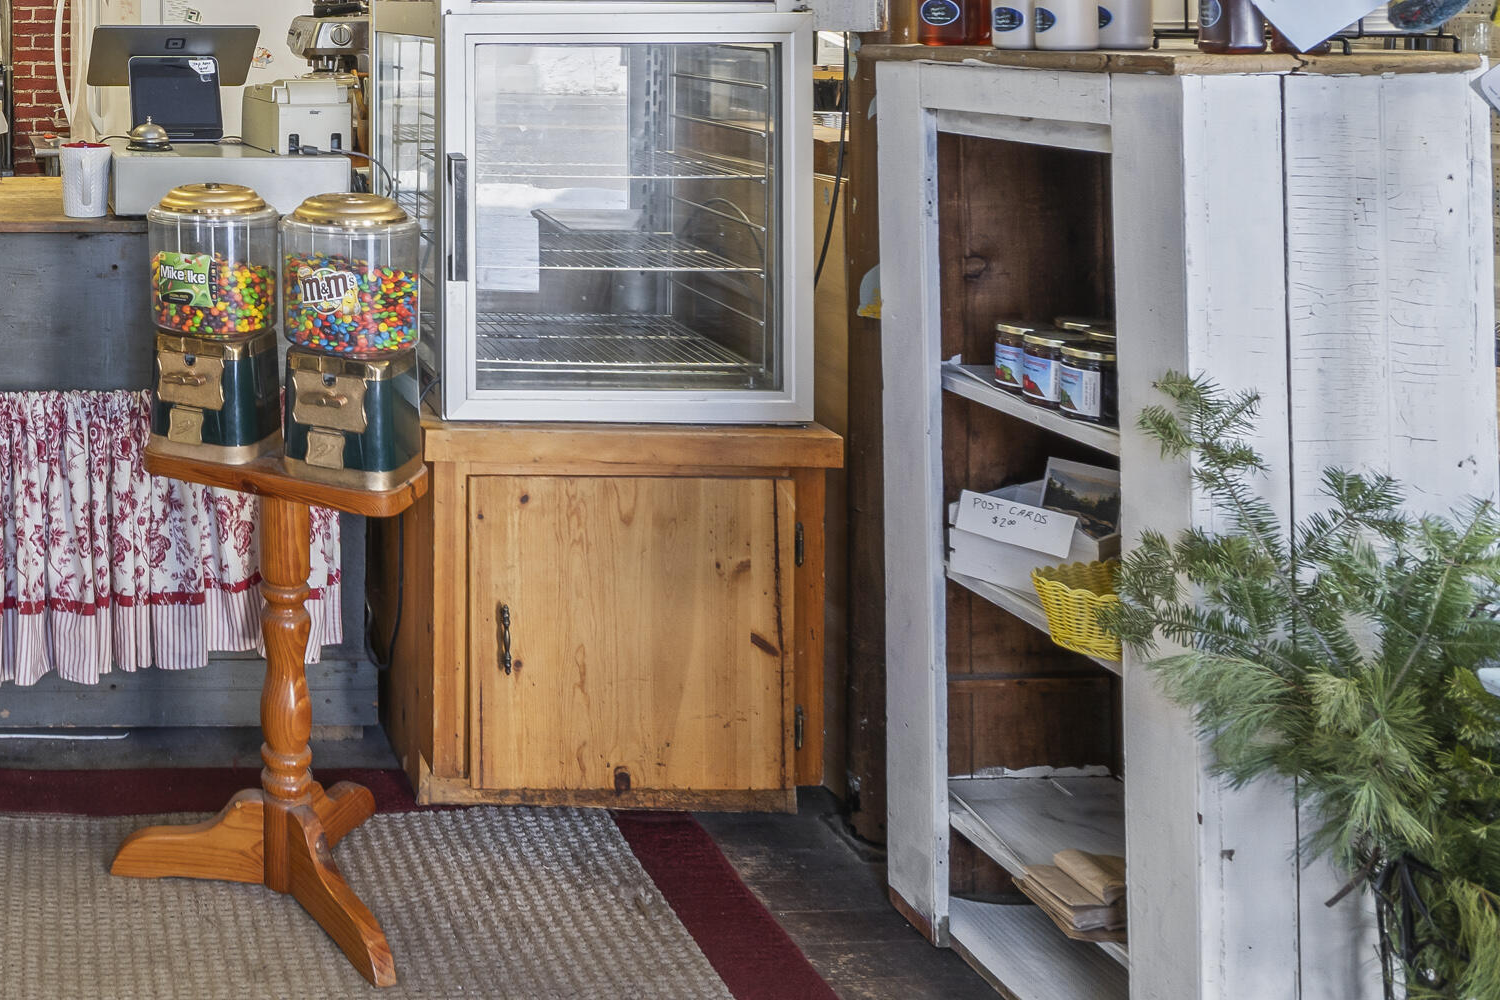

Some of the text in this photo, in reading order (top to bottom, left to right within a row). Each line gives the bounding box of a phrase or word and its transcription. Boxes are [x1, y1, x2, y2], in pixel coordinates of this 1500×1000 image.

[160, 264, 184, 280] Mike
[187, 269, 206, 284] Ike
[973, 498, 1048, 525] POST CARDS
